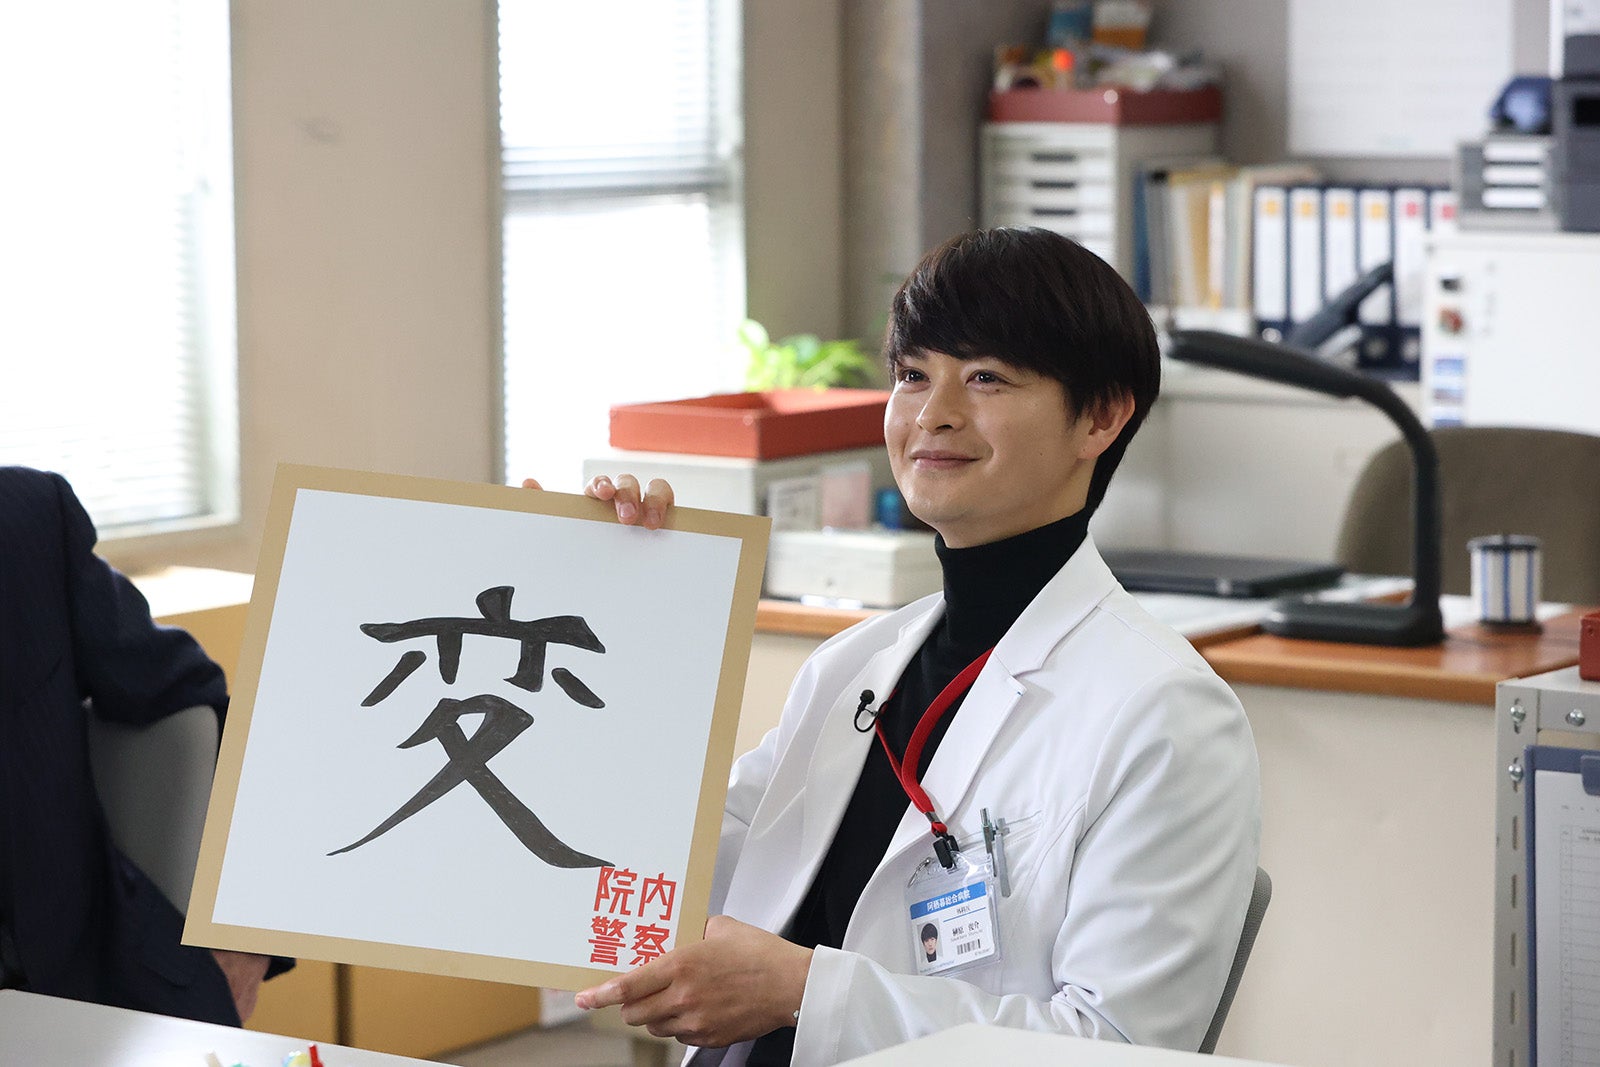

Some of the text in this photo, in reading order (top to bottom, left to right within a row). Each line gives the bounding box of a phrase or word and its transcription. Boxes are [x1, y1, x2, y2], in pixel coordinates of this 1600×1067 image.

[327, 586, 615, 870] 変
[593, 866, 677, 921] 院内
[588, 915, 670, 966] 警察
